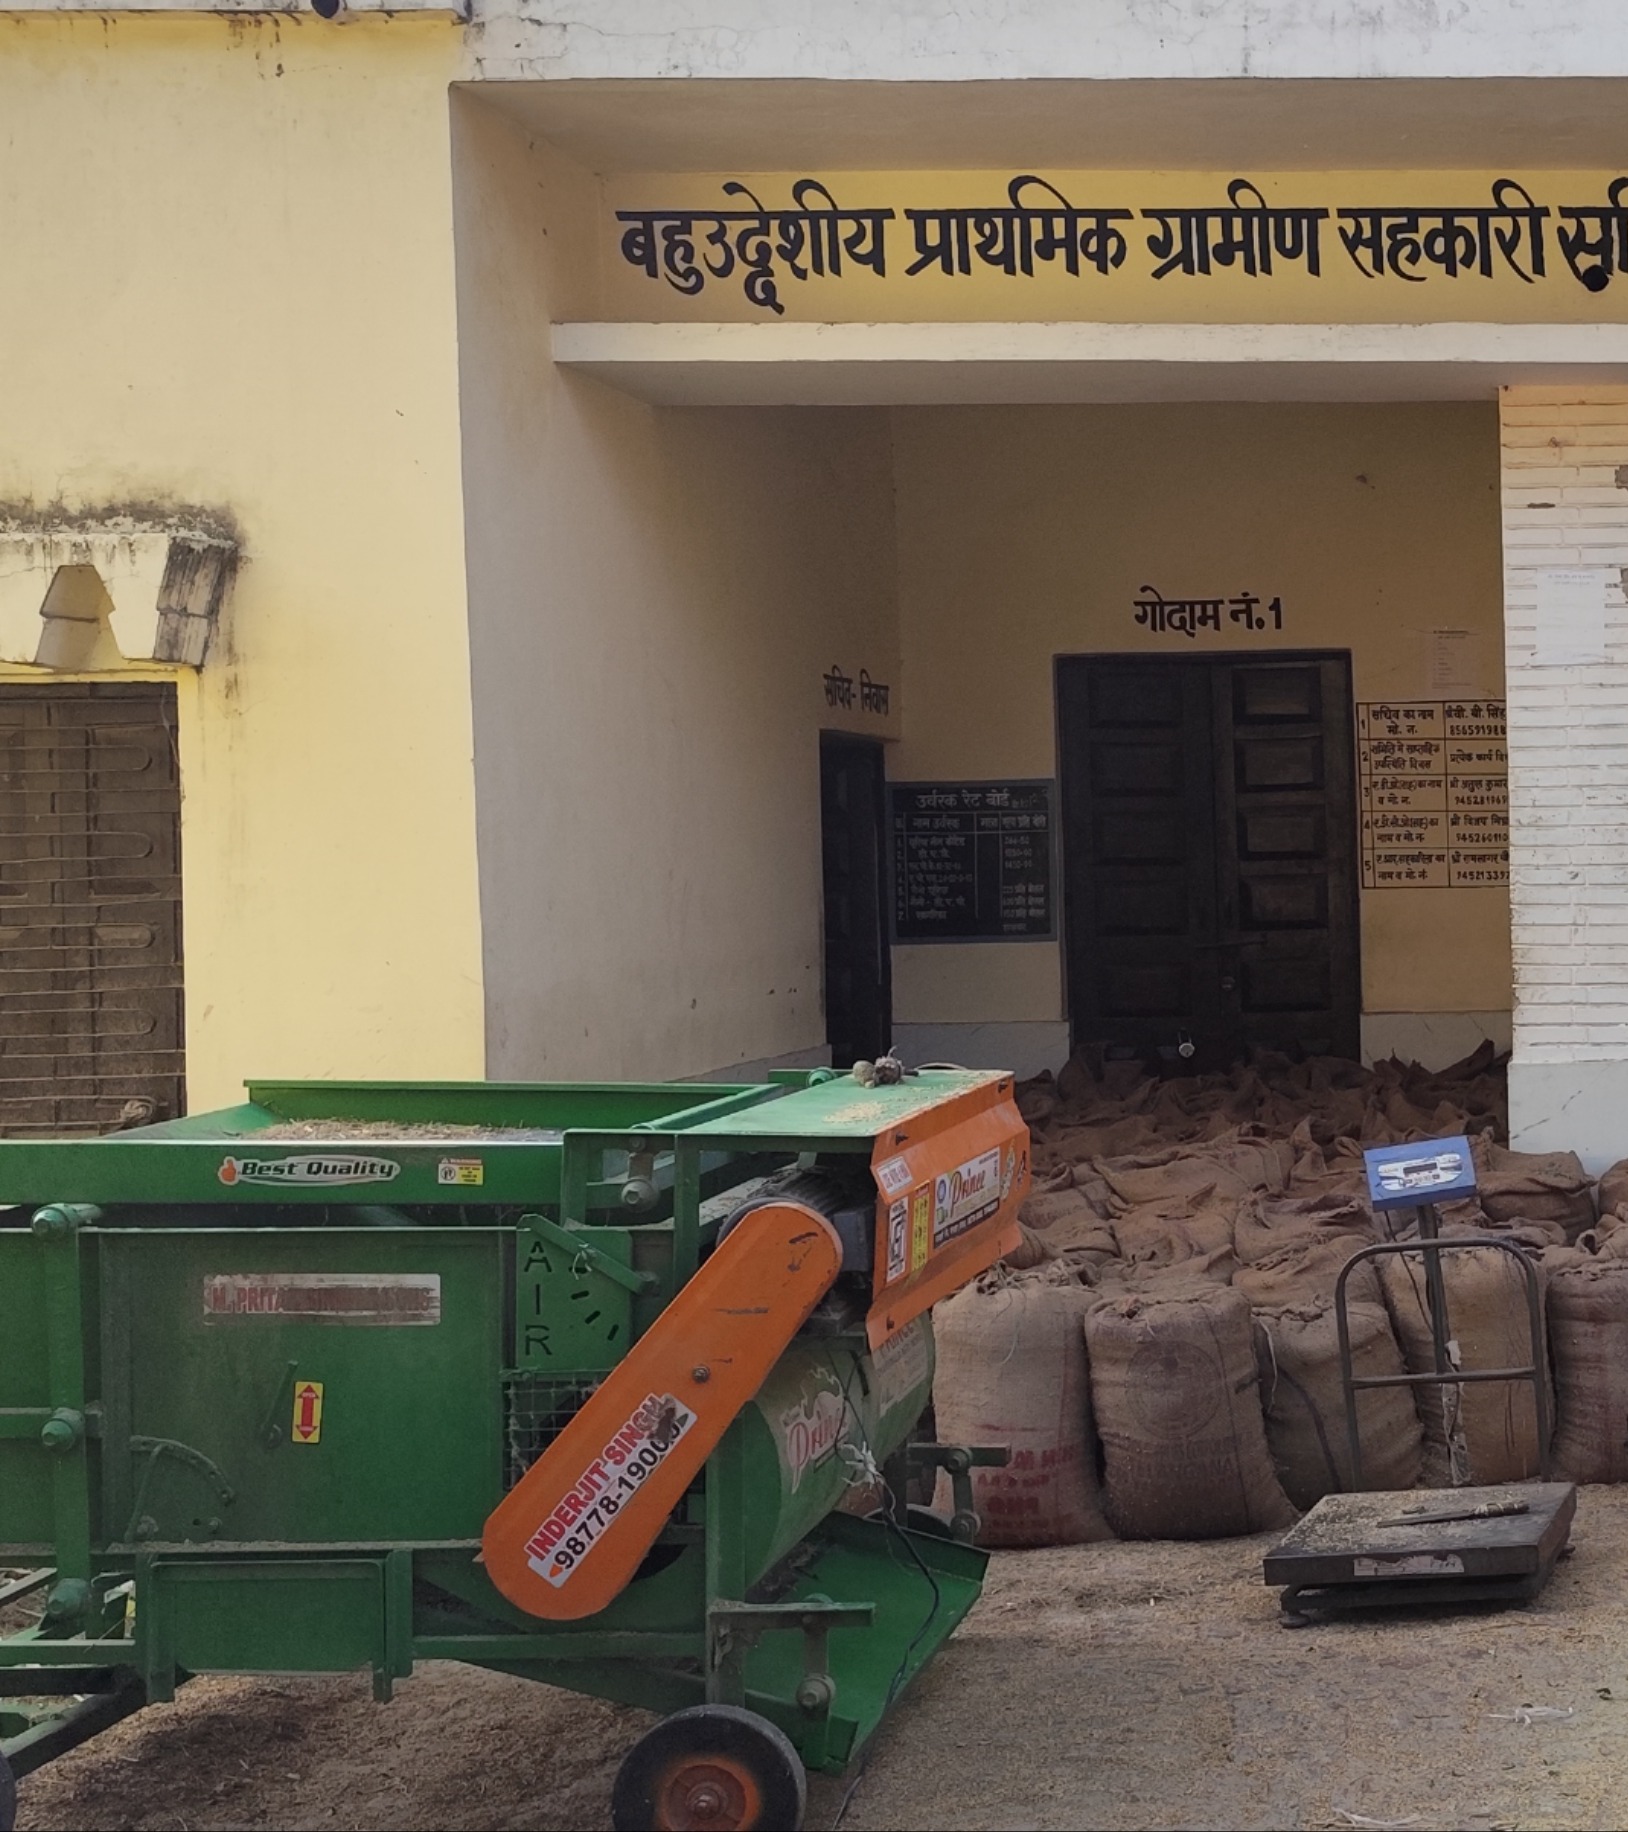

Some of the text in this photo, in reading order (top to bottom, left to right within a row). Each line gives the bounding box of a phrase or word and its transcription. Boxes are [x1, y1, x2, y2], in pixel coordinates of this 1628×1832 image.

[616, 180, 895, 313] बहुउद्देशीय
[905, 175, 1133, 277] प्राथमिक
[1142, 180, 1325, 279] ग्रामीण
[1338, 179, 1548, 282] सहकारी
[1134, 586, 1221, 637] गोदाम
[860, 668, 889, 718] निवास
[1371, 704, 1400, 720] सचिव
[1403, 709, 1416, 720] का
[1417, 709, 1434, 720] नाम
[915, 789, 958, 809] उर्वरक
[961, 789, 981, 808] रेट
[240, 1159, 397, 1178] Best Quality
[524, 1241, 552, 1356] AIR
[525, 1461, 610, 1561] INDERJIT
